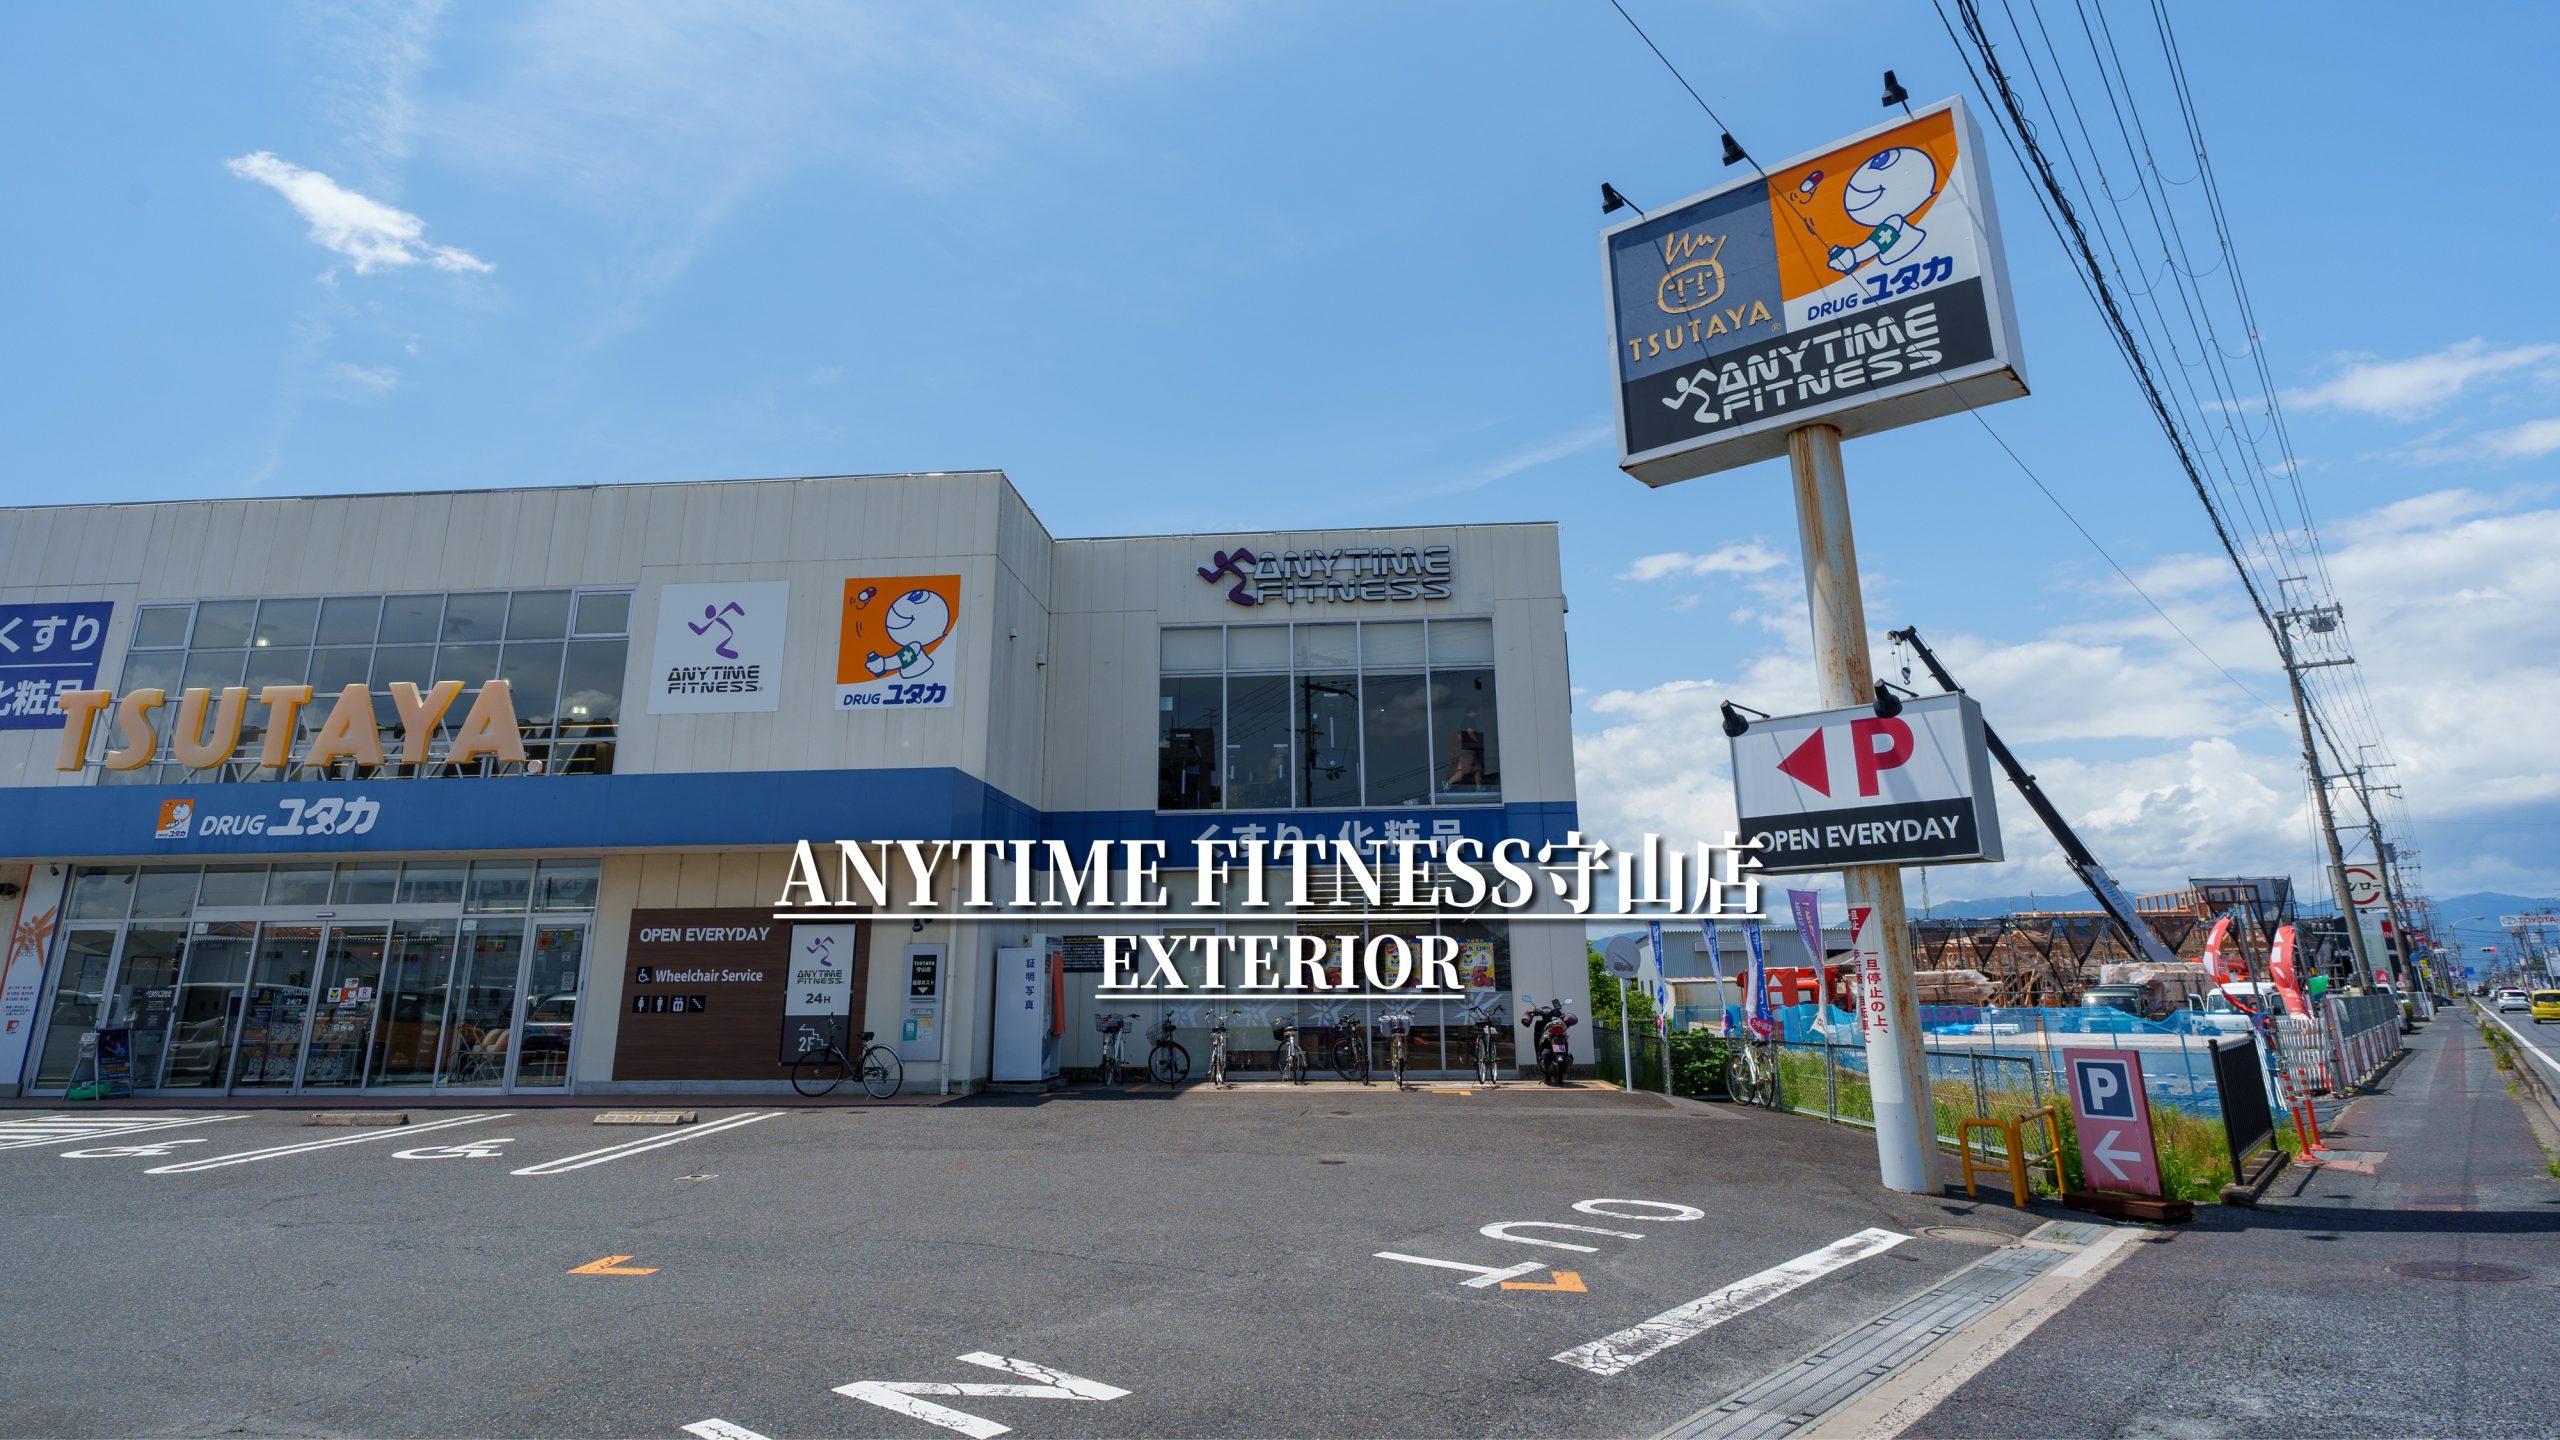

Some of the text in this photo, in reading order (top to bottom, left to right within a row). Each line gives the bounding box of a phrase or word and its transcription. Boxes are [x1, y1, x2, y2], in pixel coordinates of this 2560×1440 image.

[1862, 255, 1953, 304] ユタカ
[1807, 292, 1858, 321] DRUG
[1628, 300, 1773, 363] TSUTAYA
[1717, 302, 1940, 396] ANYTIME
[1723, 337, 1943, 421] FITNESS
[1253, 546, 1450, 580] ANYTIME
[1257, 576, 1452, 605] FITNESS
[0, 615, 100, 654] くすり
[667, 665, 760, 682] ANYTIME
[667, 681, 758, 695] FITNESS
[843, 683, 947, 706] DRUG ユタカ
[56, 680, 526, 772] TSUTAYA
[1850, 716, 1914, 798] P
[199, 795, 381, 836] DRUG ユタカ
[1755, 815, 1960, 854] OPEN EVERYDAY
[640, 927, 770, 943] OPEN EVERYDAY
[655, 969, 763, 983] Wheelchair Service
[796, 969, 842, 978] ANYTIME
[796, 977, 842, 985] FITNESS
[1024, 958, 1036, 1010] 証明写真
[1863, 951, 1889, 1034] 一旦停止の上、
[805, 992, 831, 1004] 24H
[2087, 1067, 2118, 1110] P
[1372, 1197, 1705, 1290] OUT
